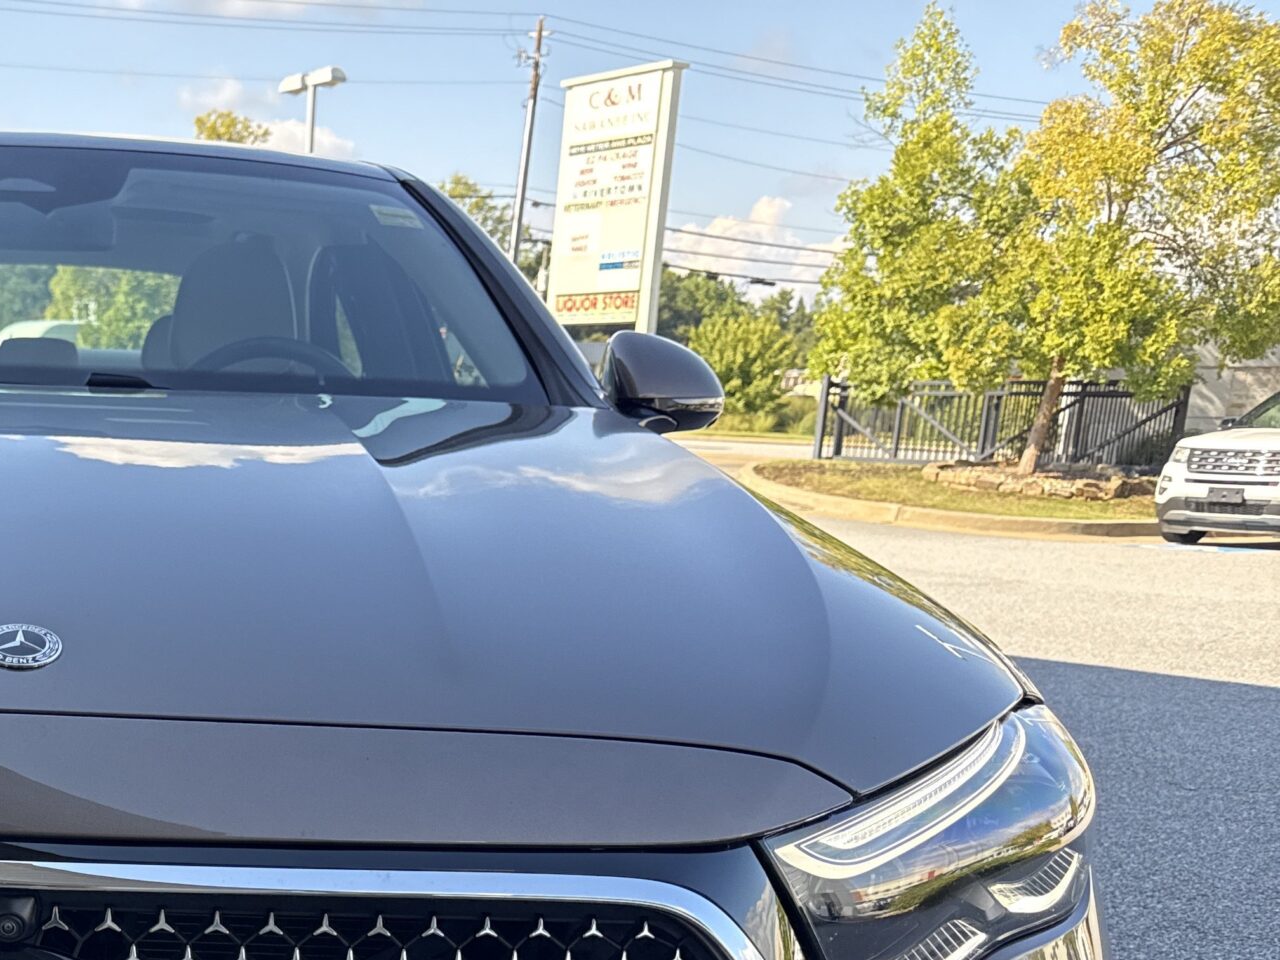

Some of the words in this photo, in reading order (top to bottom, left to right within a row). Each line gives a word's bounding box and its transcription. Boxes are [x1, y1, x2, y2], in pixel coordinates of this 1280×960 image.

[589, 91, 600, 109] C
[603, 87, 620, 107] &
[626, 83, 642, 103] M
[555, 296, 599, 313] LIQUOR
[602, 293, 636, 311] STORE
